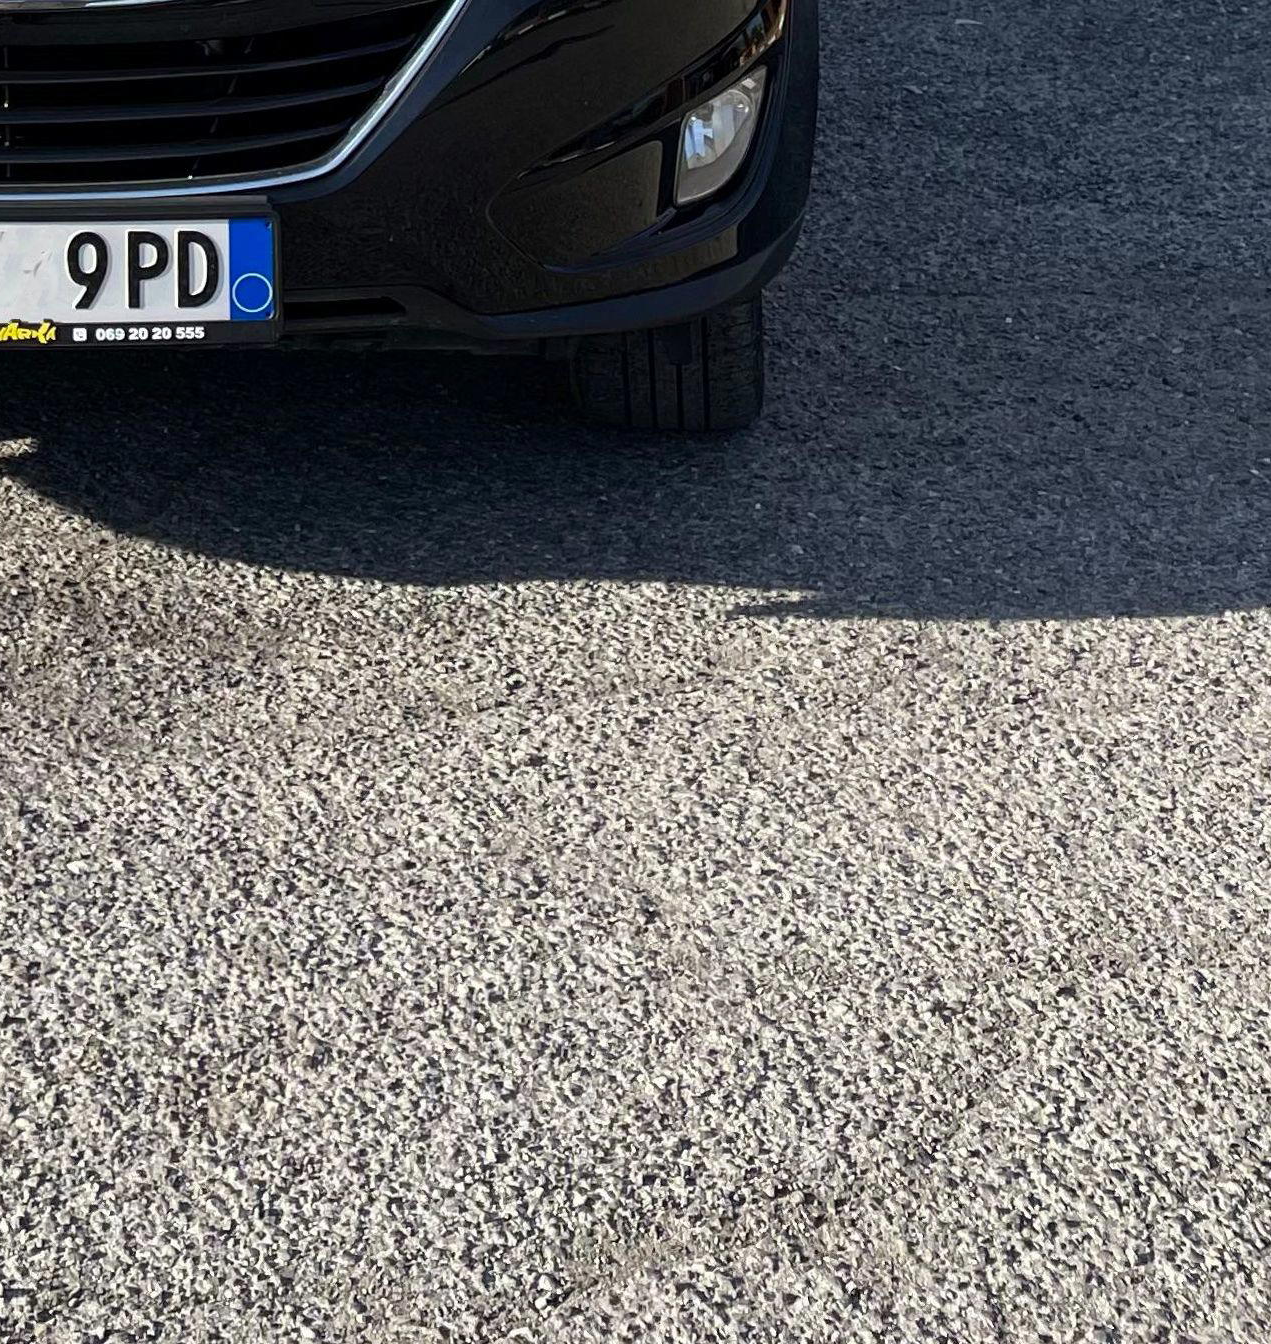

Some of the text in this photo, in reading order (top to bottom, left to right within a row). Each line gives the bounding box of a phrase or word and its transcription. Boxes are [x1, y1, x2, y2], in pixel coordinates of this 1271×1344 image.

[95, 327, 126, 341] 069
[128, 327, 149, 341] 20
[151, 327, 172, 341] 20
[175, 326, 205, 340] 555
